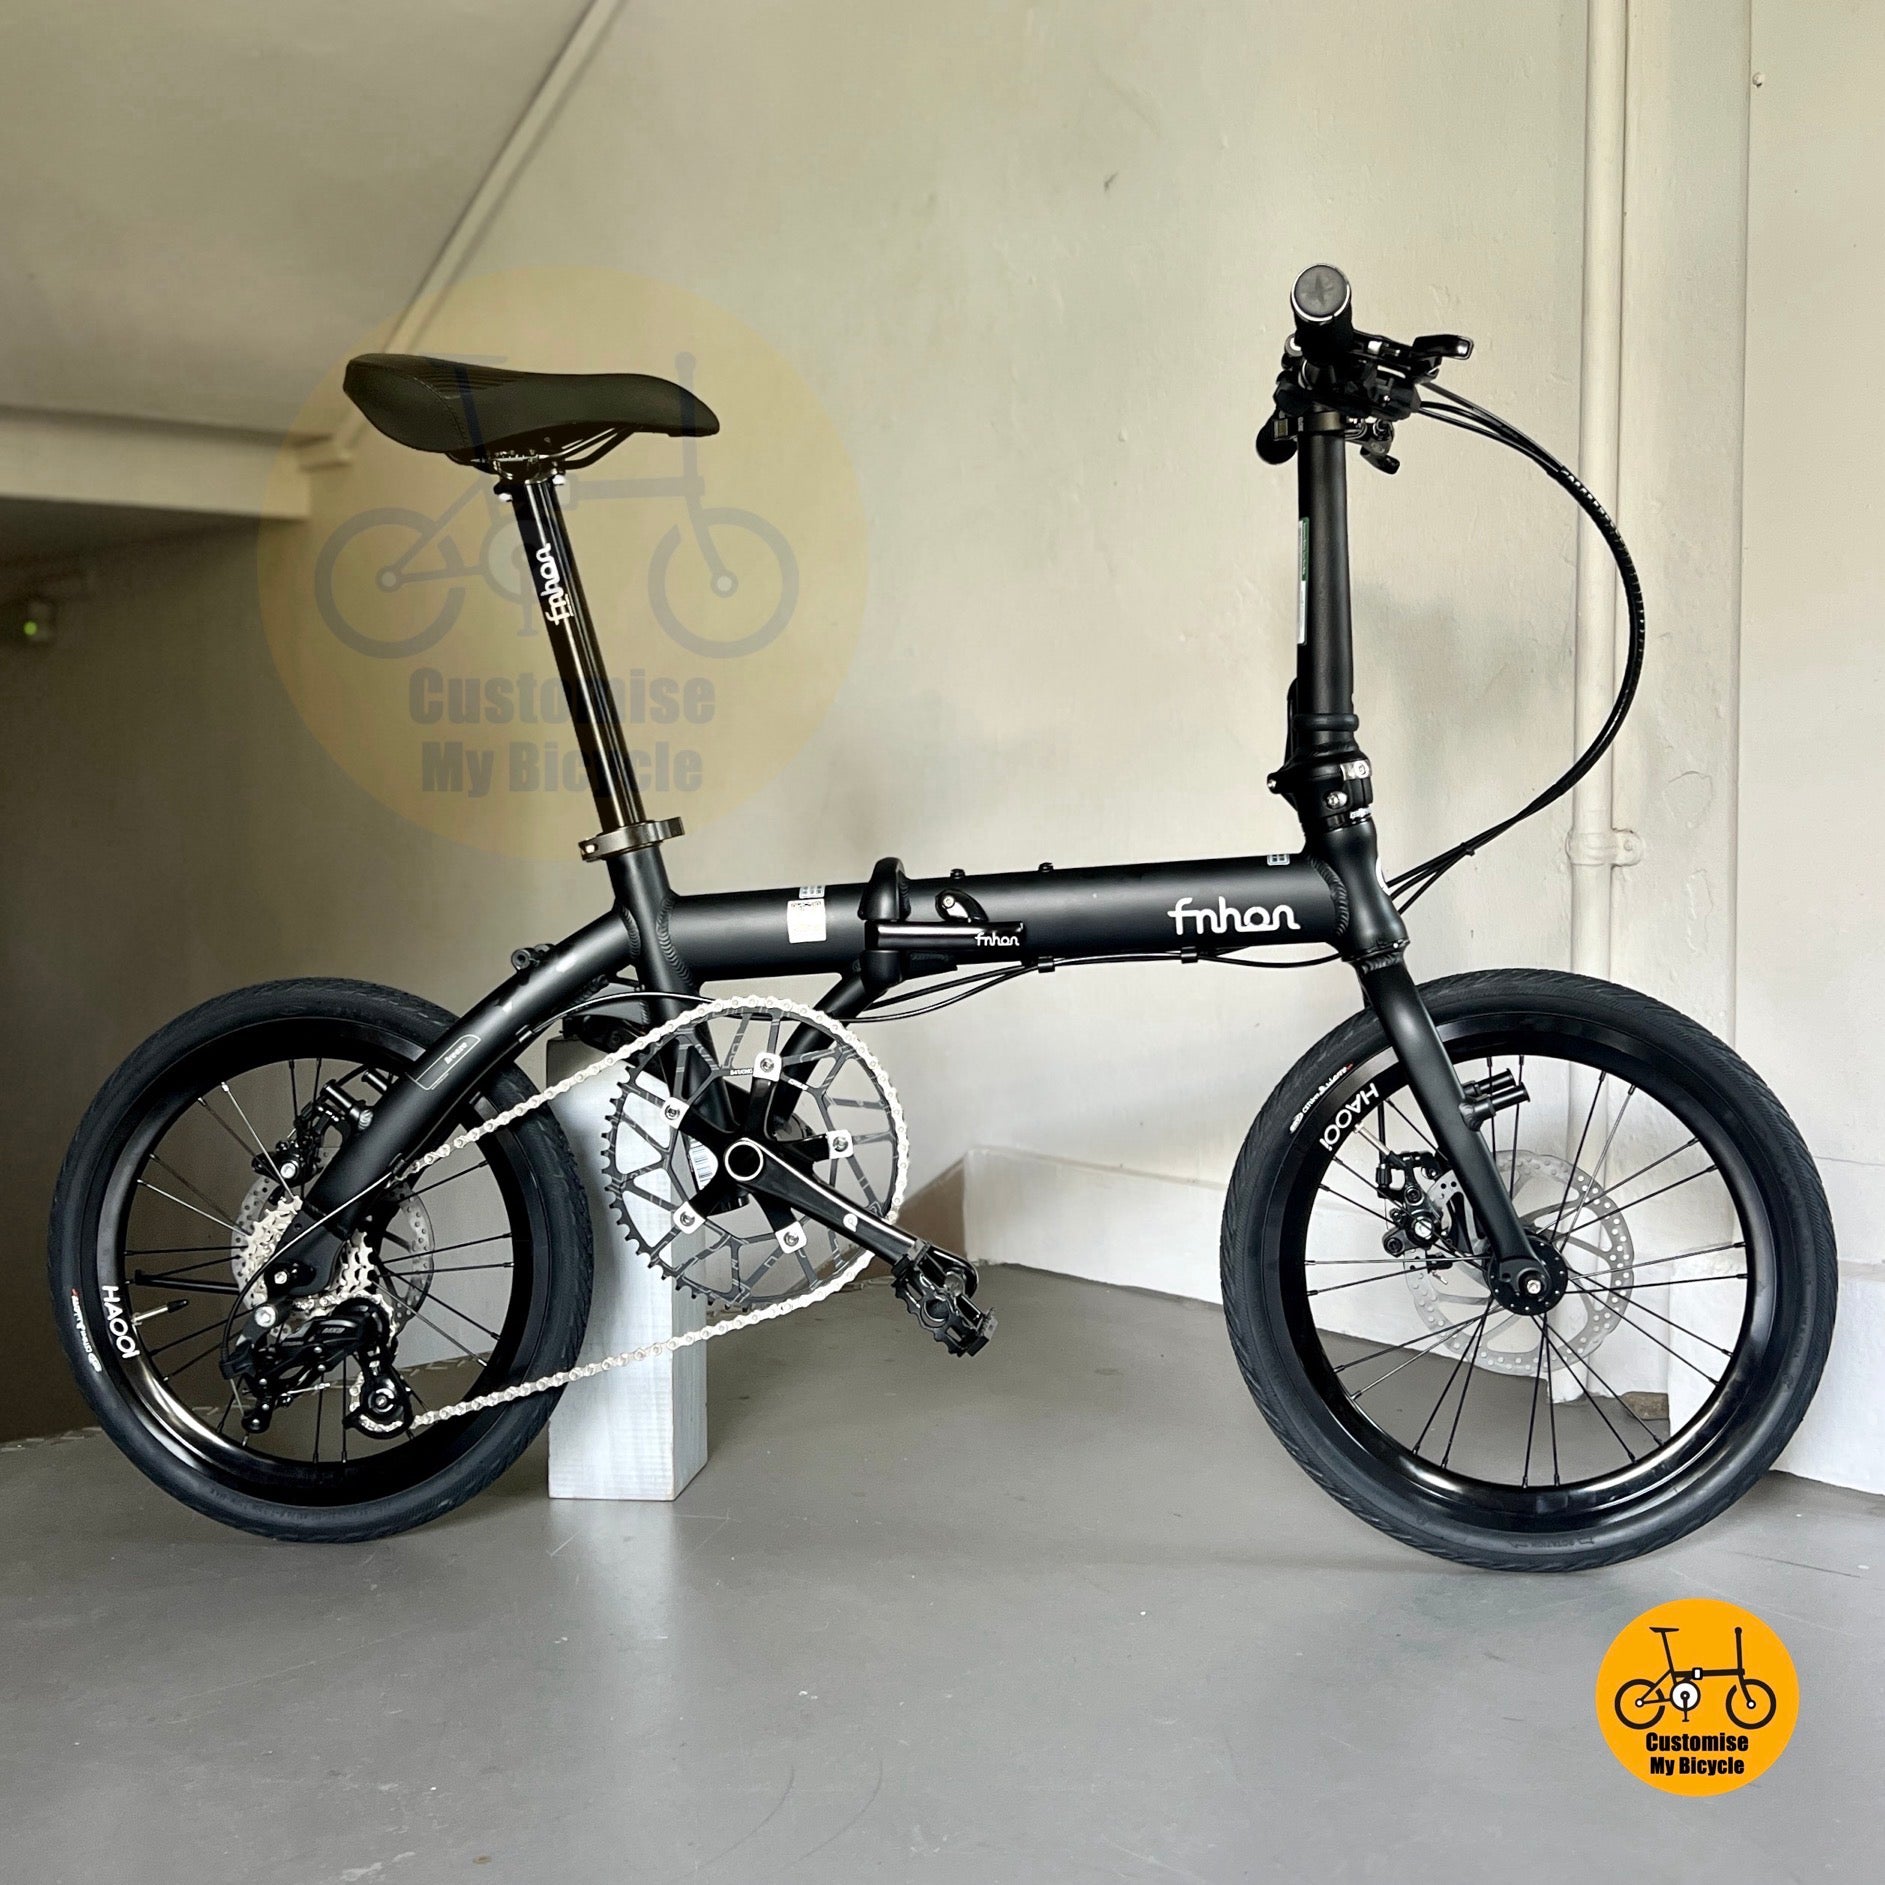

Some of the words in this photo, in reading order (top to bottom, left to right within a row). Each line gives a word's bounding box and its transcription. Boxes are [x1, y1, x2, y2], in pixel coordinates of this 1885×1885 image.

[535, 542, 571, 626] fnhon
[1167, 896, 1301, 936] fnhon
[975, 932, 1020, 947] fnhon
